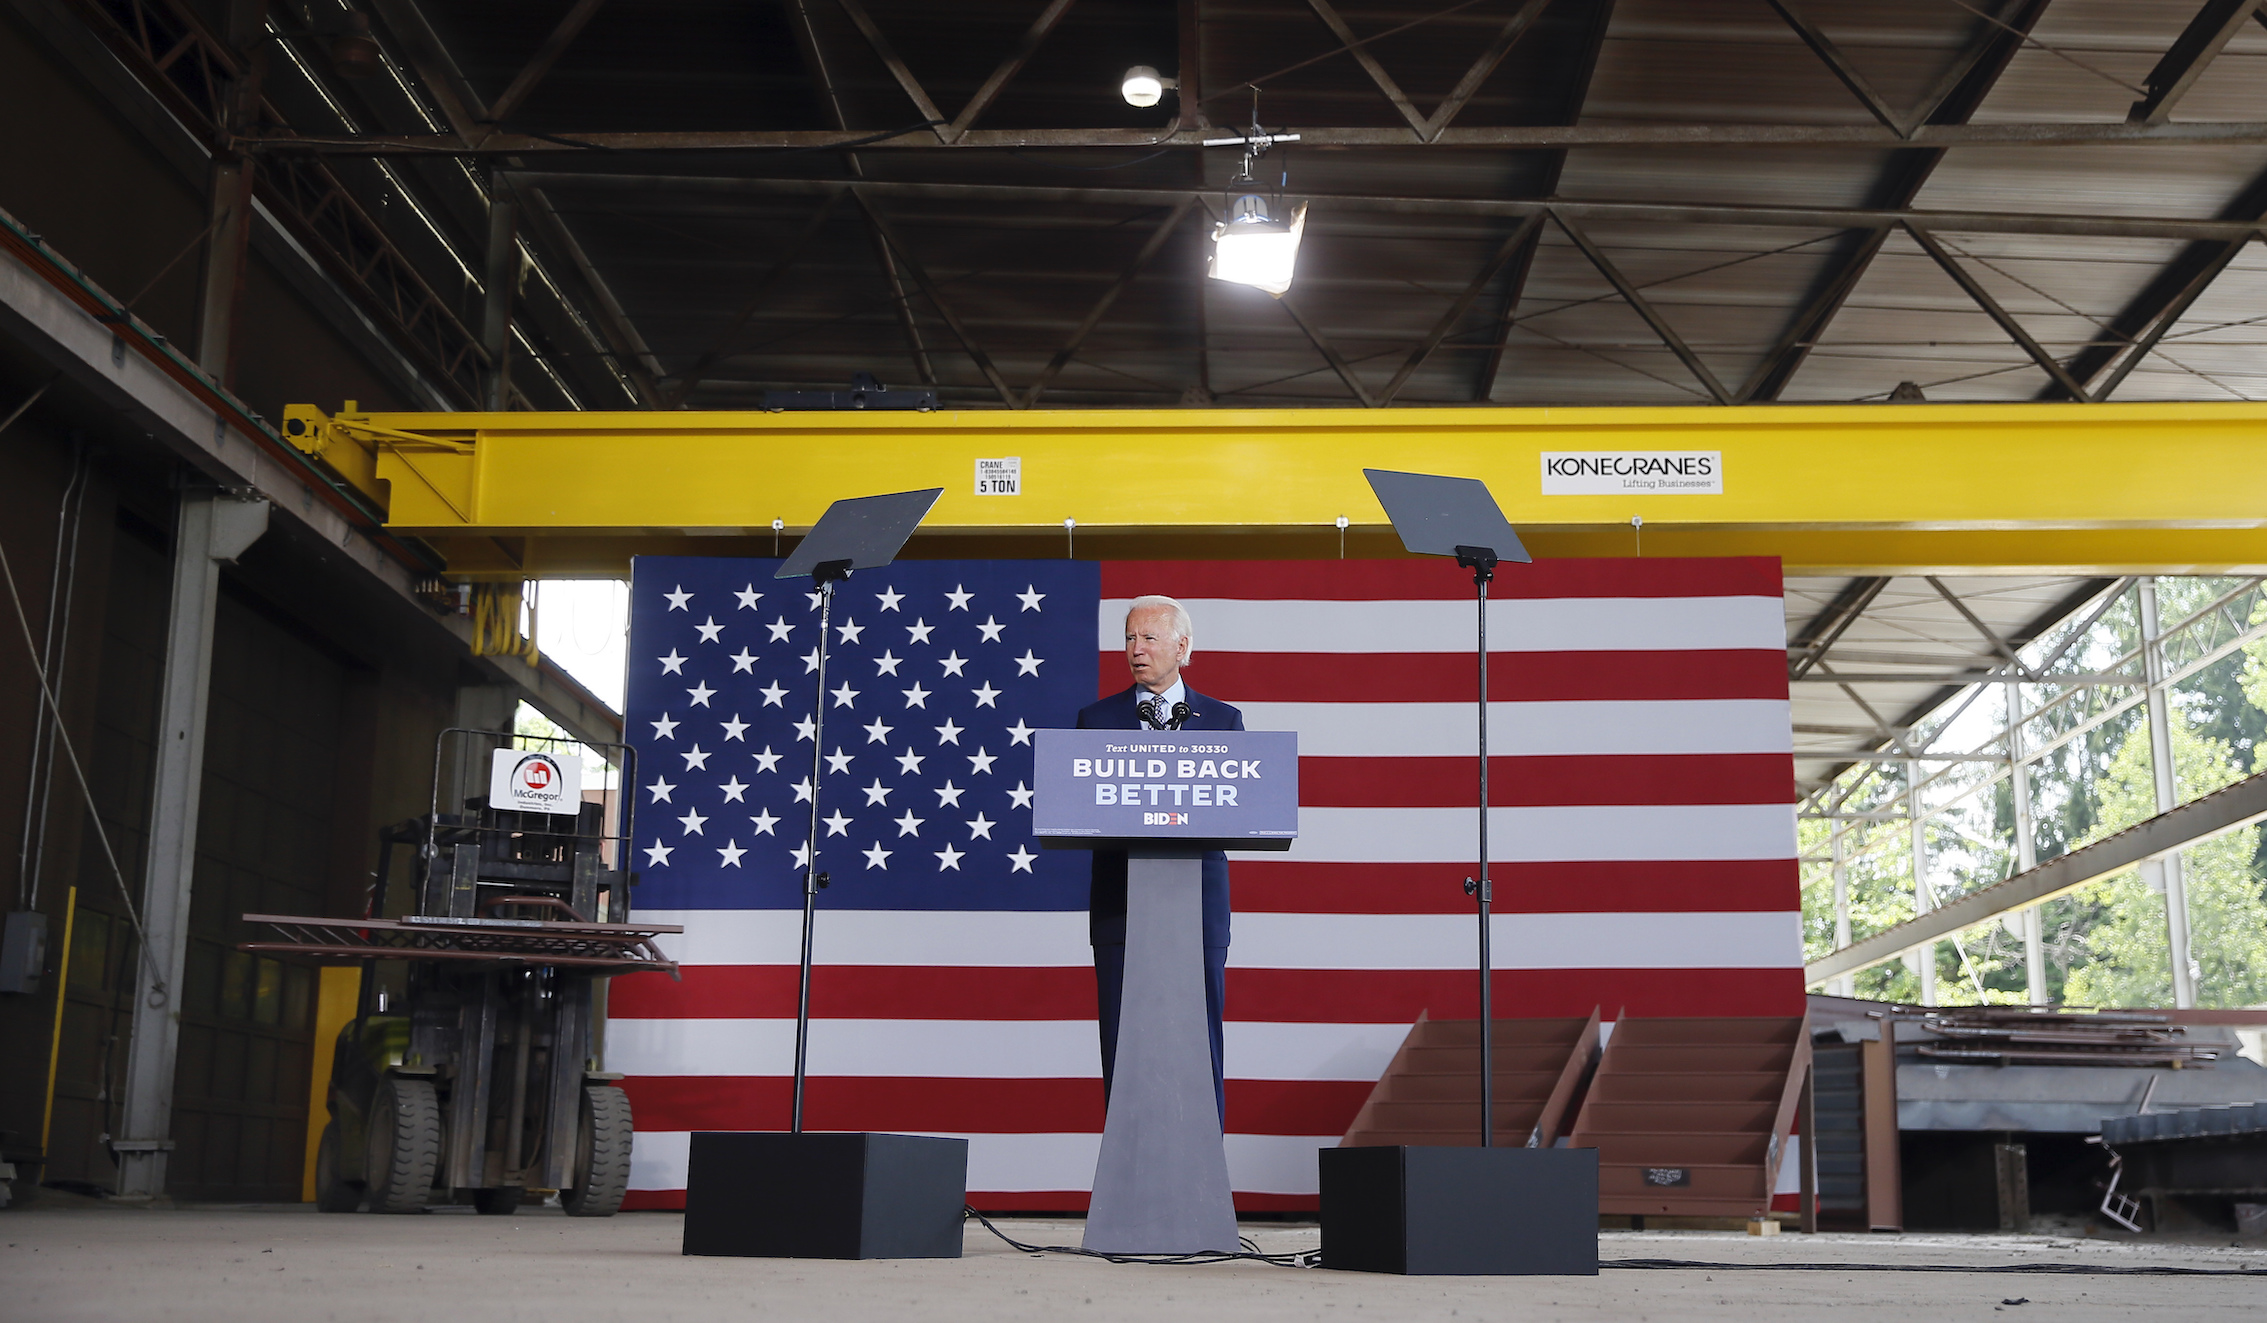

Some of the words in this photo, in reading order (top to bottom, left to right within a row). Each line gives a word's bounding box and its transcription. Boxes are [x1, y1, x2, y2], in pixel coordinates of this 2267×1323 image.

[980, 461, 1003, 469] CRANE
[1548, 457, 1712, 476] KONECRANES
[980, 480, 987, 493] 5
[992, 480, 1016, 493] TON
[1623, 479, 1656, 489] Lifting
[1658, 479, 1712, 488] Businesses
[1106, 744, 1128, 753] Text
[1130, 744, 1176, 753] UNITED
[1179, 745, 1188, 753] to
[1191, 745, 1228, 754] 30330
[1073, 758, 1167, 778] BUILD
[1177, 759, 1261, 779] BACK
[514, 789, 559, 802] McGregor
[1095, 783, 1239, 807] BETTER
[1143, 812, 1189, 826] BIDEN
